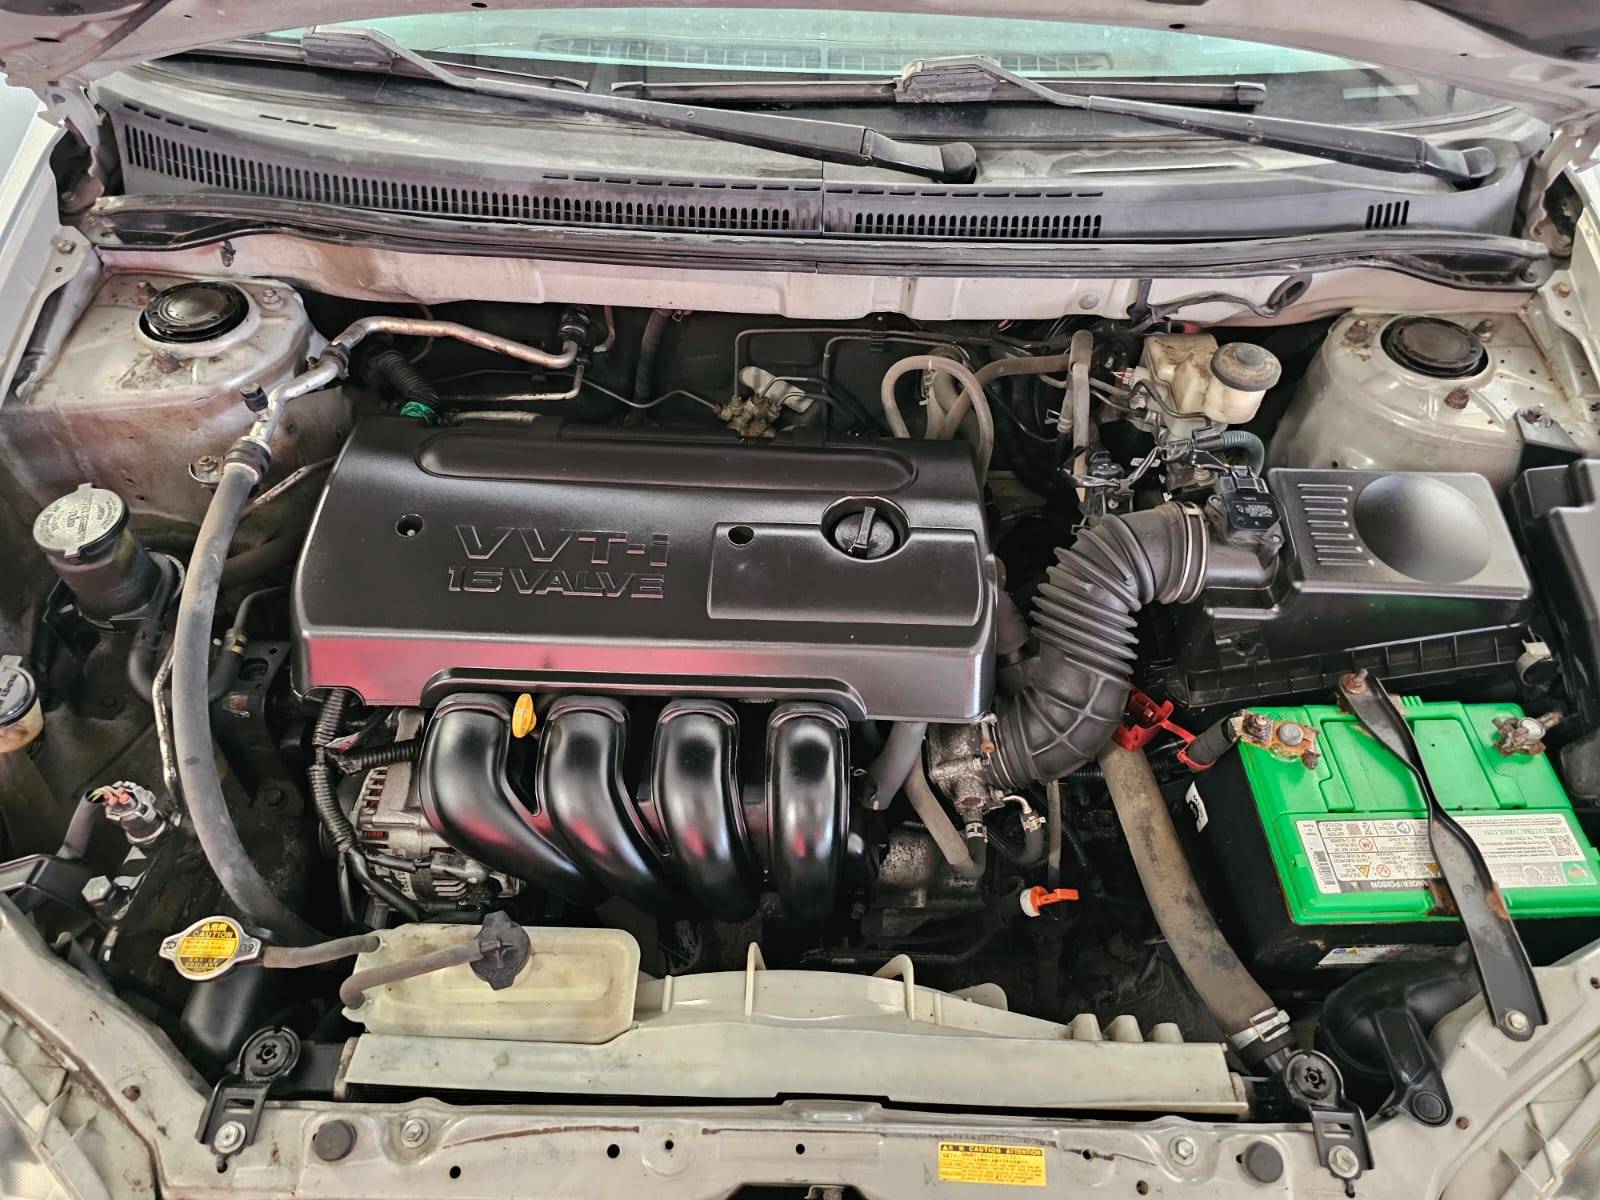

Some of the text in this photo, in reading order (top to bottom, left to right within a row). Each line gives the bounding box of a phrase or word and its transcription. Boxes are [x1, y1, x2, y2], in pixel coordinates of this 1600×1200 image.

[448, 565, 665, 599] 16 VALVE
[192, 930, 234, 938] CAUTION
[968, 1145, 1001, 1154] CAUTION
[1006, 1148, 1042, 1156] ATTENTION
